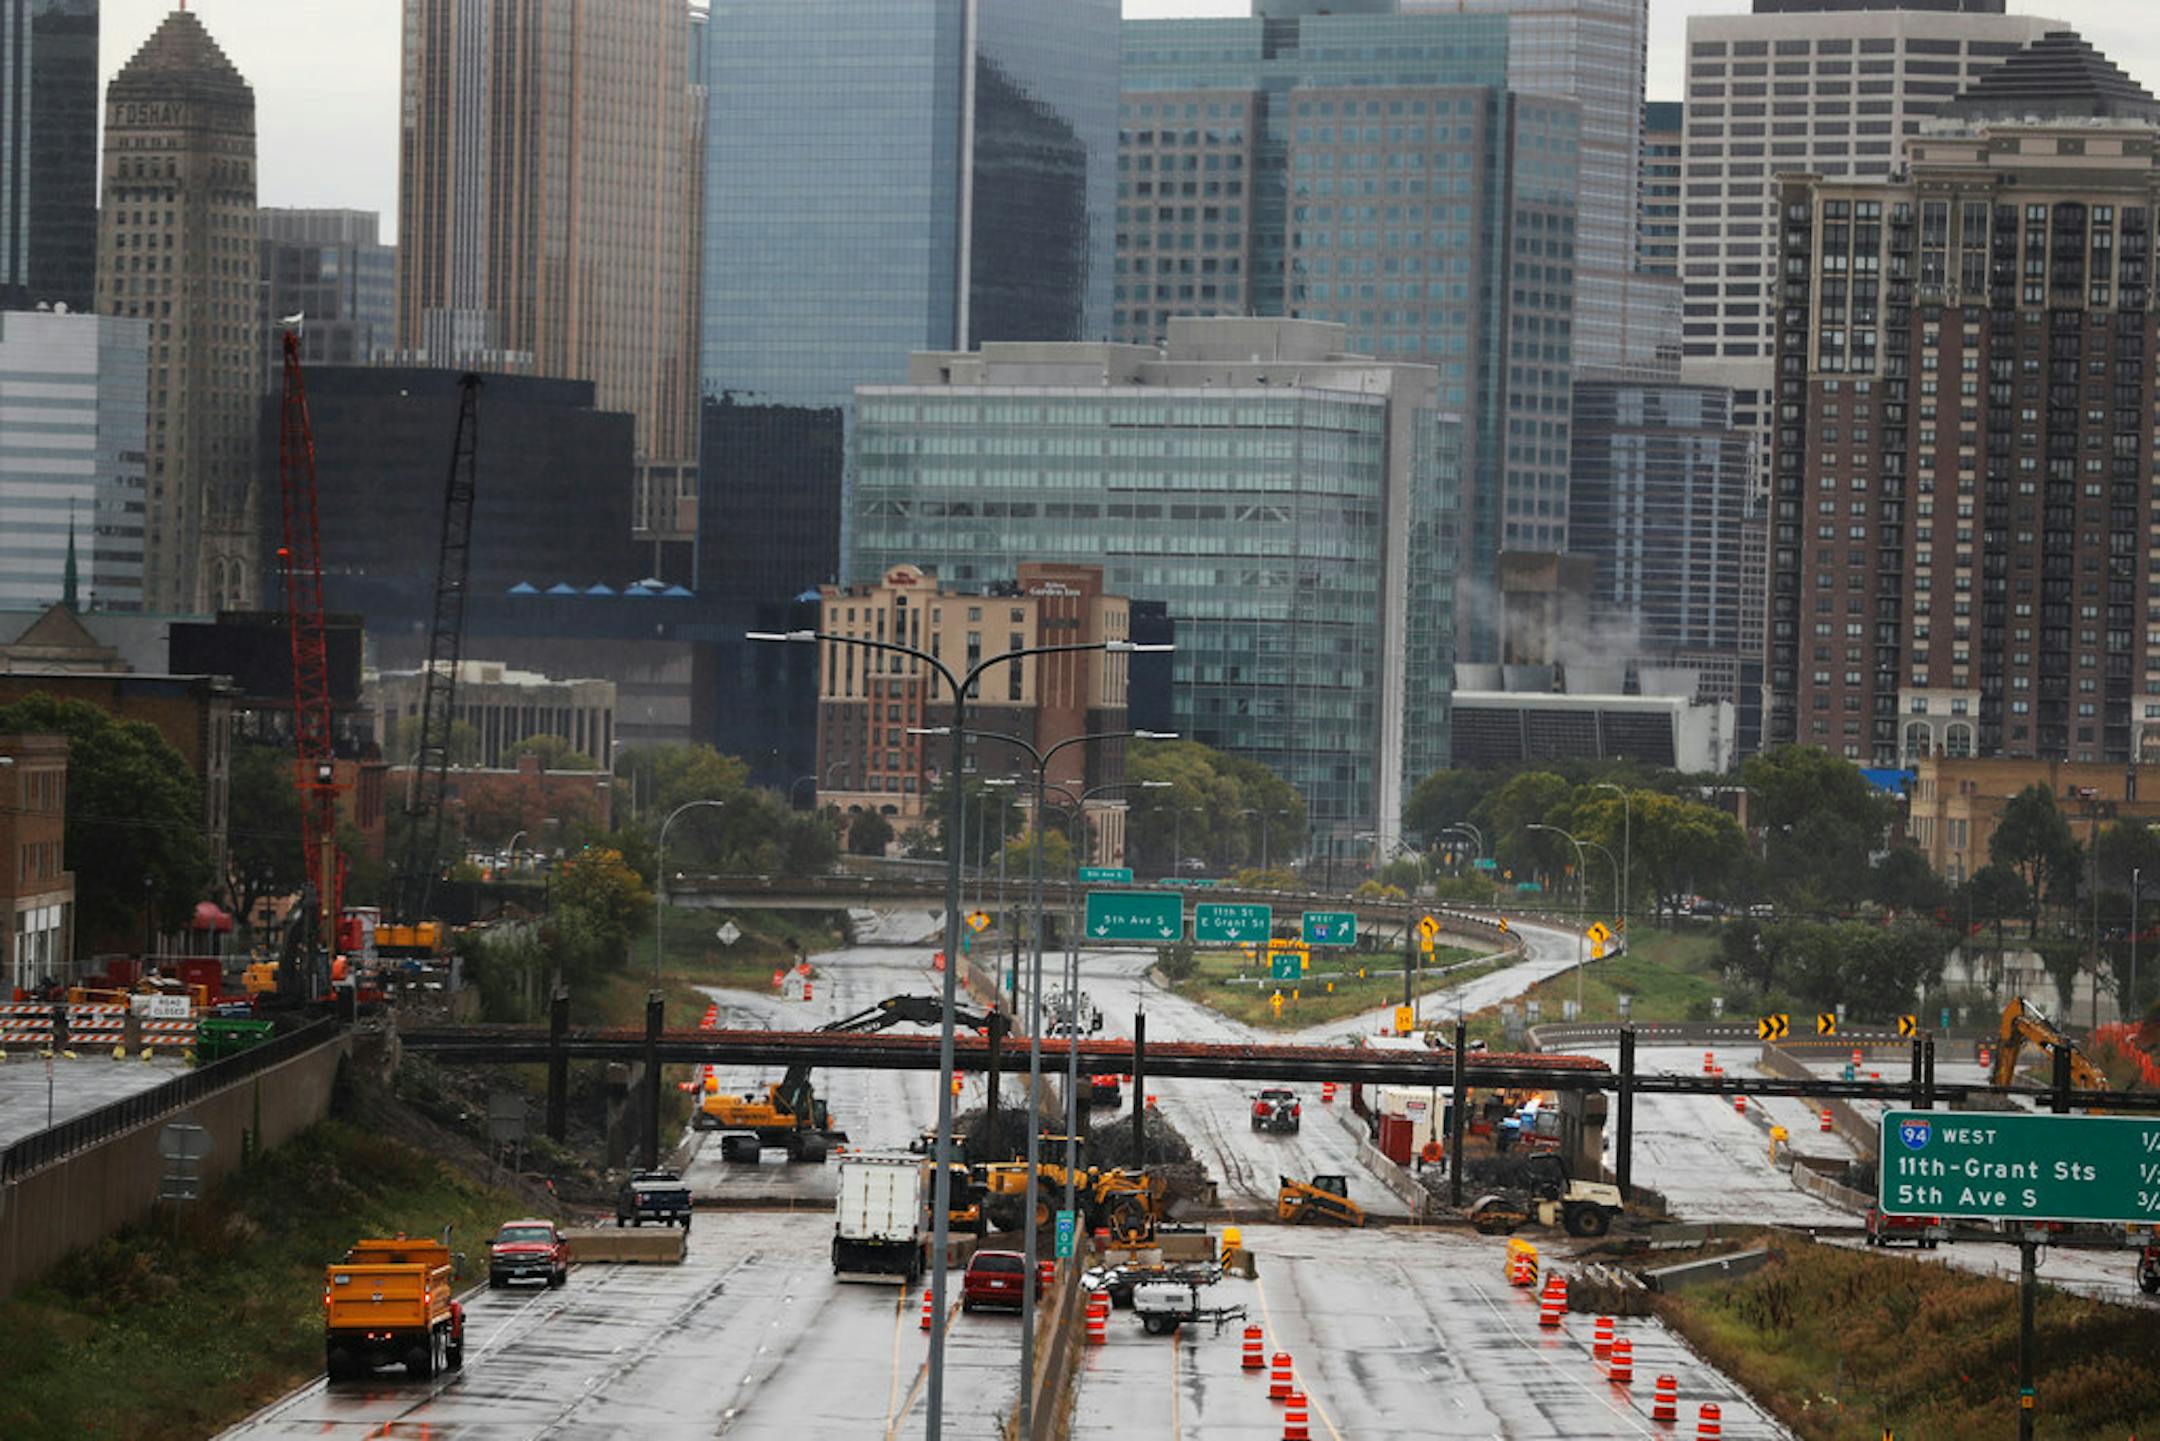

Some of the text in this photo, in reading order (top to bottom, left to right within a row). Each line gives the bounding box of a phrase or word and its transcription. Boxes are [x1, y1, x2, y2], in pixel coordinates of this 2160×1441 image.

[115, 104, 182, 124] FOSHAY
[1213, 908, 1254, 917] 11th St
[1104, 915, 1164, 925] 5th Ave S
[1202, 917, 1265, 928] E Grant St
[159, 998, 182, 1007] ROAD
[153, 1007, 186, 1016] CLOSED
[1903, 1127, 1928, 1142] 94
[1942, 1127, 1997, 1145] WEST
[1898, 1156, 2160, 1184] 11th-Grant Sts 1/
[1899, 1185, 1943, 1205] 5th
[1958, 1187, 2007, 1207] Ave
[2022, 1188, 2038, 1208] S
